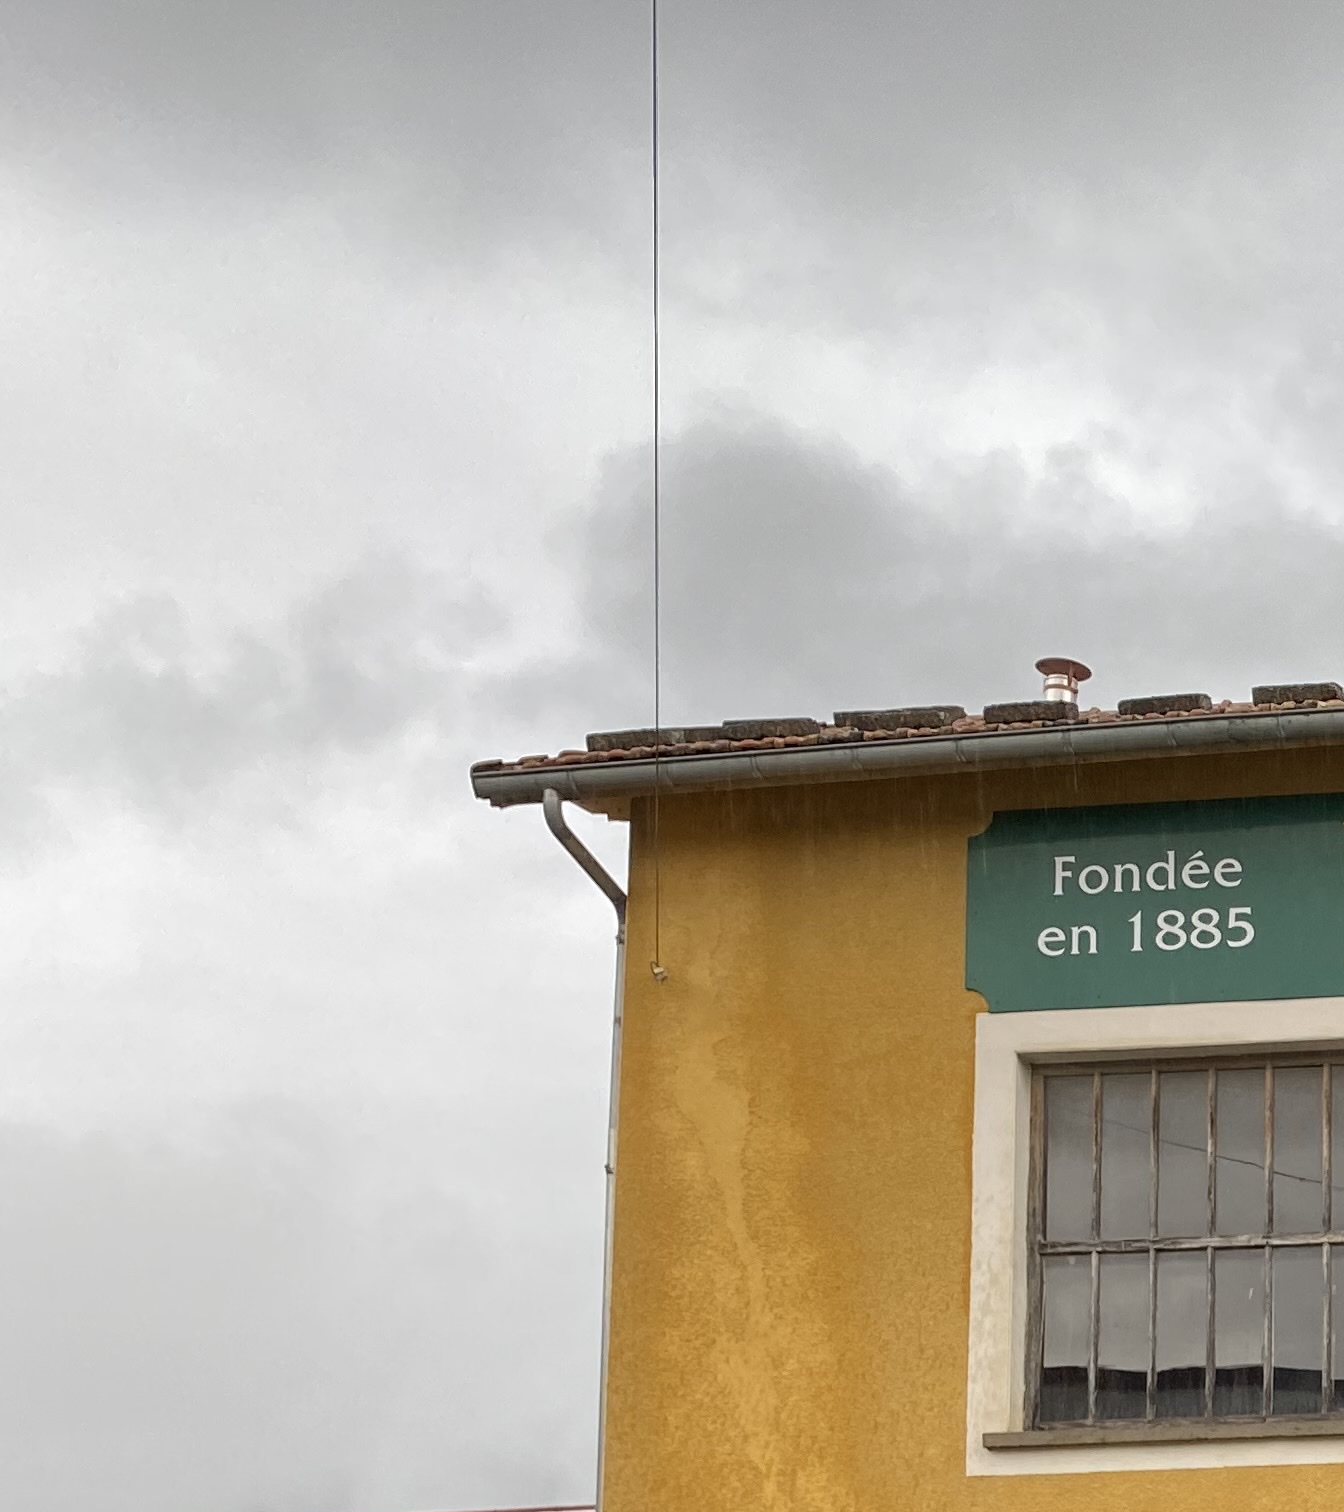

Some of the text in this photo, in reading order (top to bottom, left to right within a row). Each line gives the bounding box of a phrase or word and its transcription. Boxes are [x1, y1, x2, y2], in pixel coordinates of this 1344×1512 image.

[1052, 847, 1244, 896] Fondée
[1038, 906, 1256, 957] en 1885
